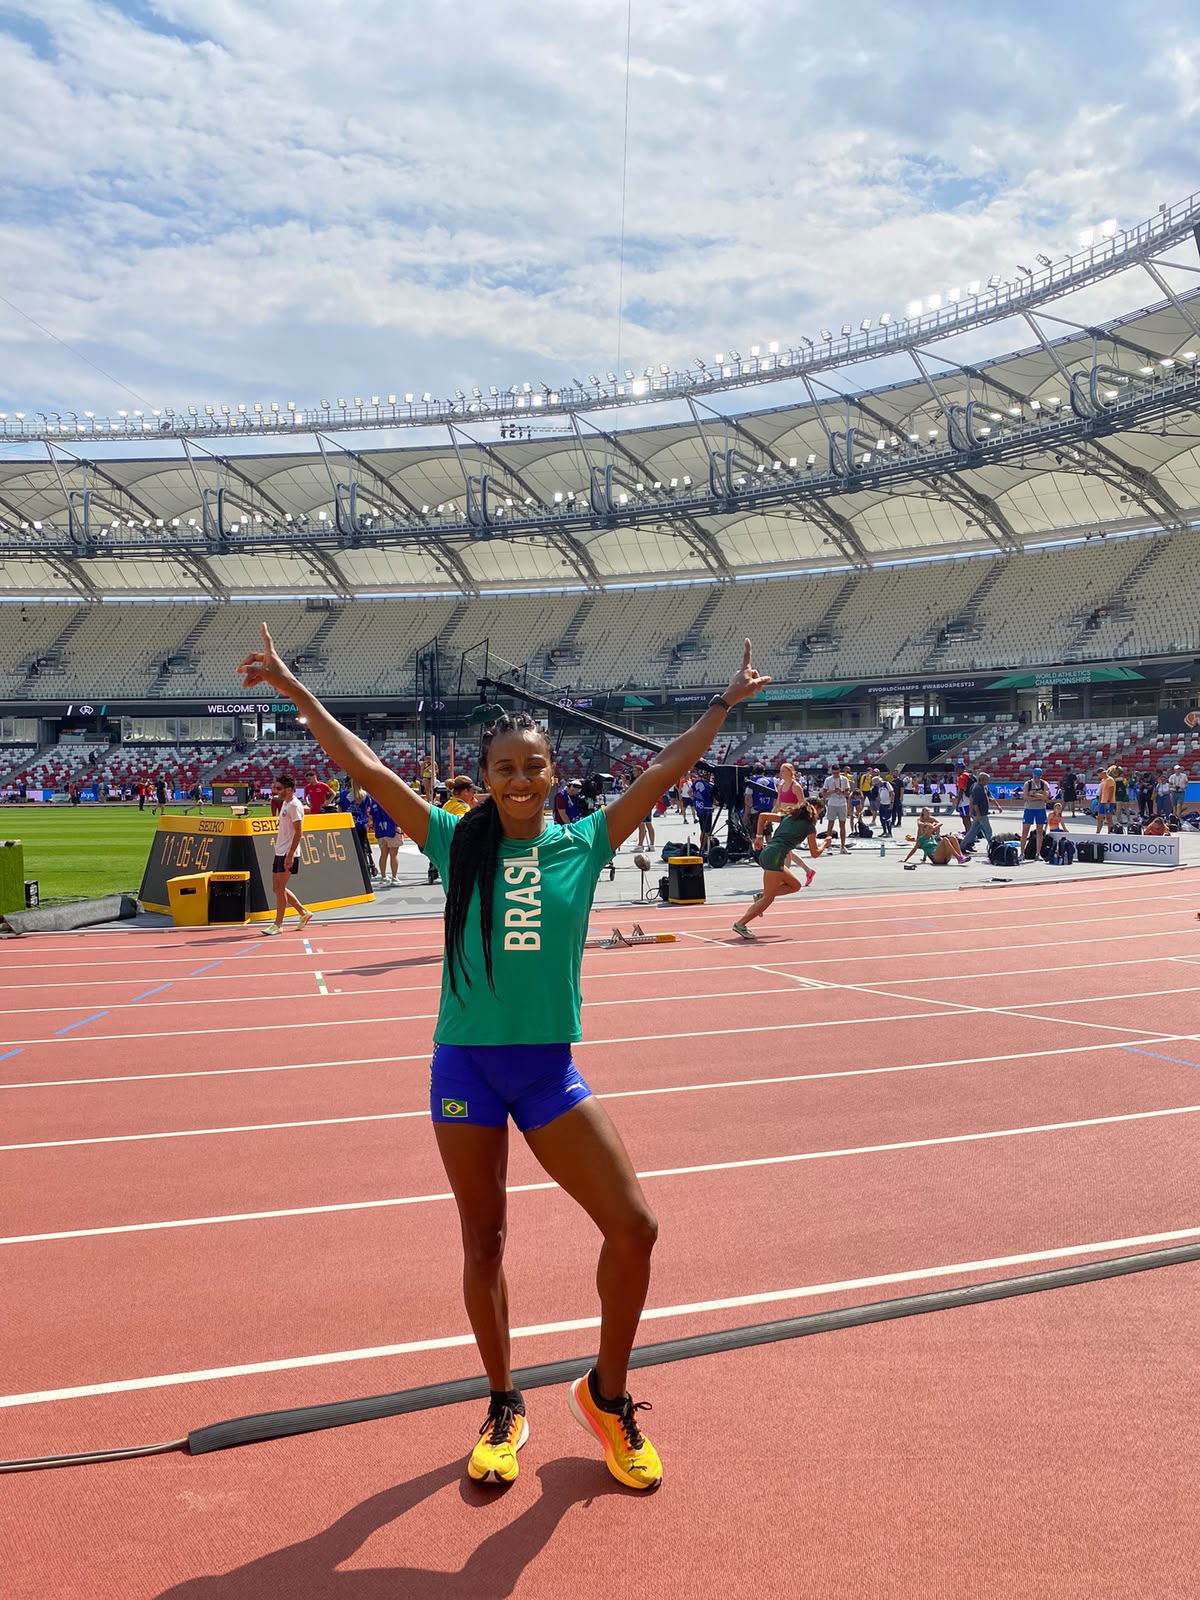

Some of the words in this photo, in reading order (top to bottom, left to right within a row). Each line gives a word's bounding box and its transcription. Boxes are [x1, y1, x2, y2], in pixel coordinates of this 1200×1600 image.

[1057, 670, 1091, 678] ATHLETICS
[1035, 676, 1091, 686] CHAMPIONSHIPS
[207, 704, 255, 713] WELCOME
[256, 704, 270, 713] TO
[271, 704, 299, 712] BUDA
[198, 820, 225, 833] SEIKO
[251, 820, 280, 832] SEIK
[503, 846, 542, 951] BRASIL
